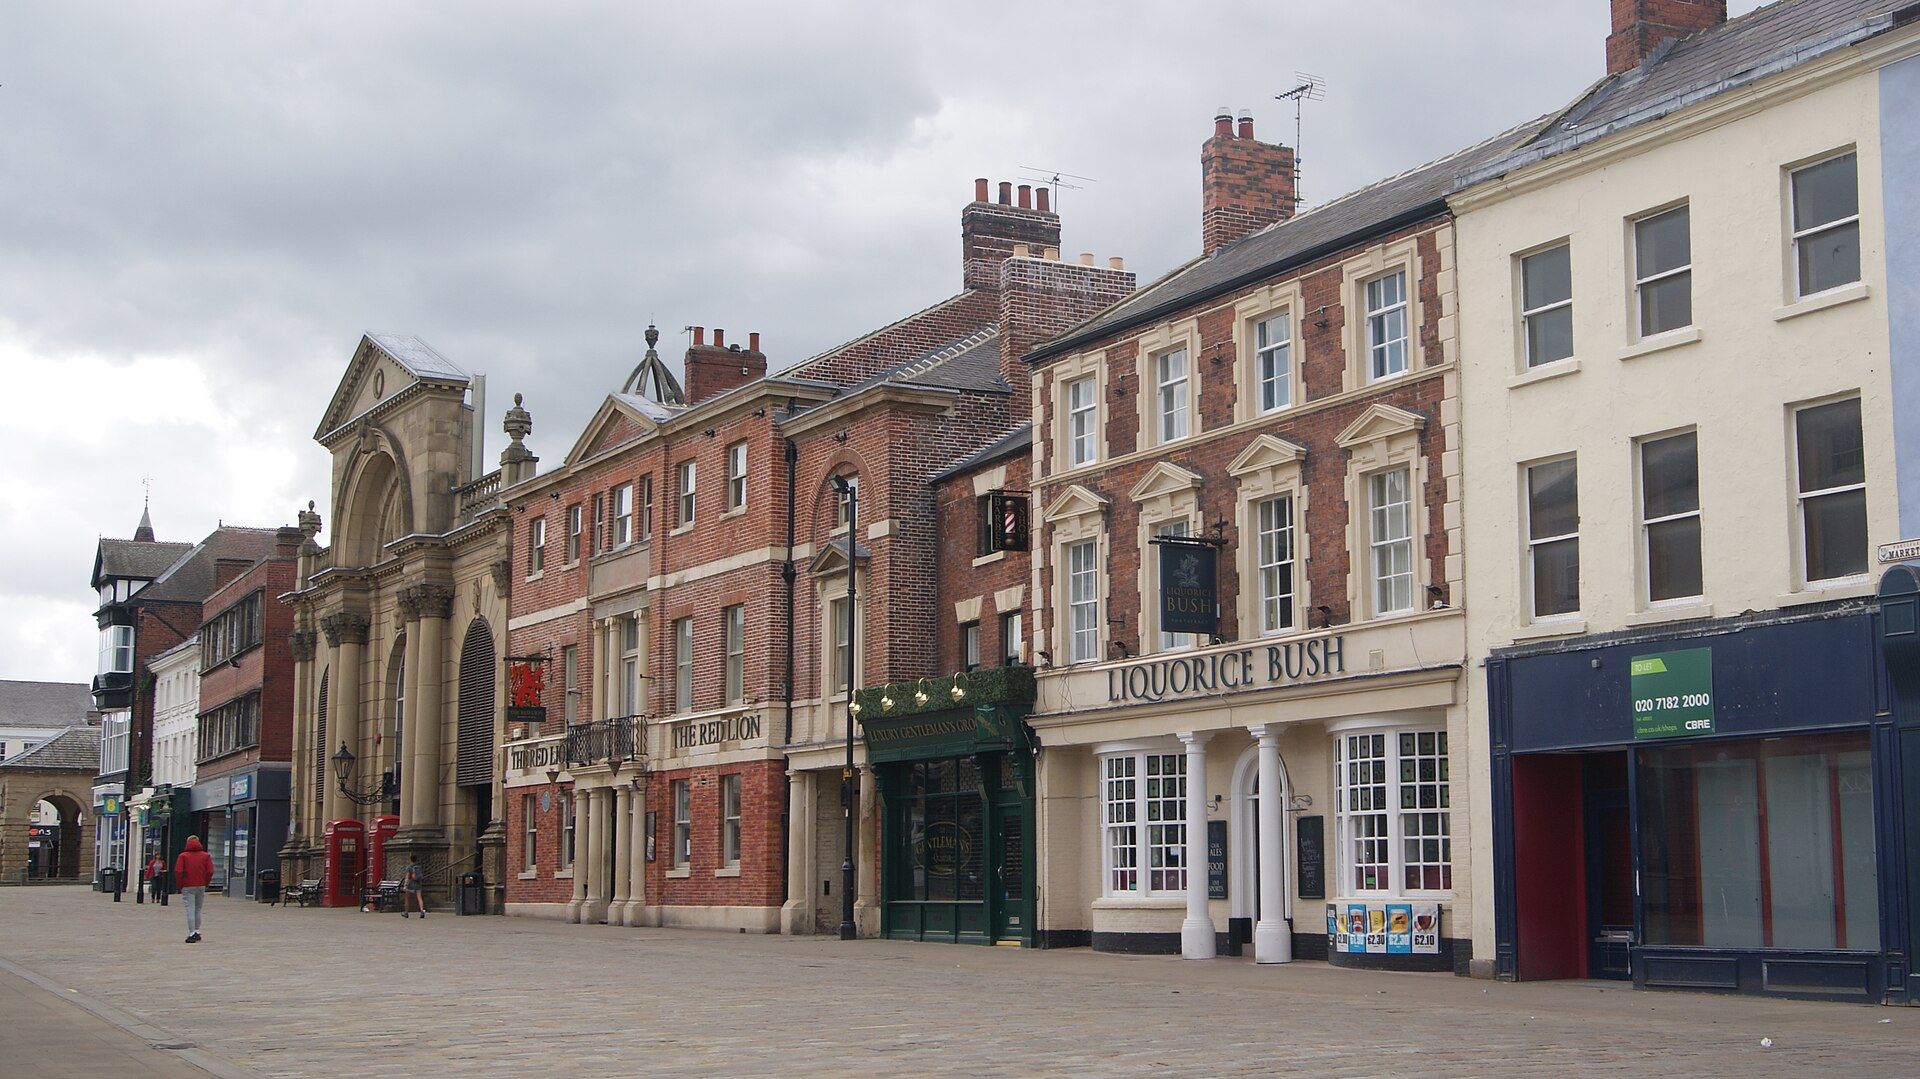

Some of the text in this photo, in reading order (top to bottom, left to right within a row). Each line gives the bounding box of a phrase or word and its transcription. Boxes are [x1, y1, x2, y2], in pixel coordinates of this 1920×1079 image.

[993, 497, 1002, 548] BARBER
[1018, 506, 1026, 541] SHOP
[1888, 546, 1920, 560] MARKET
[1166, 586, 1211, 597] LIQUORICE
[1167, 597, 1211, 613] BUSH
[1107, 636, 1345, 702] LIQUORICE BUSH
[1635, 662, 1653, 672] TO LET
[1635, 693, 1709, 712] 020 7182 2000
[672, 714, 760, 749] THE RED LION
[1637, 724, 1677, 734] cbre.co.uk/shops
[1685, 719, 1711, 730] CBRE
[869, 727, 900, 741] LUXURY
[511, 744, 566, 770] THE RED LIO
[1209, 849, 1223, 857] ALES
[1207, 862, 1225, 871] FOOD
[1367, 934, 1385, 945] £2.30
[1414, 935, 1435, 946] £2.10
